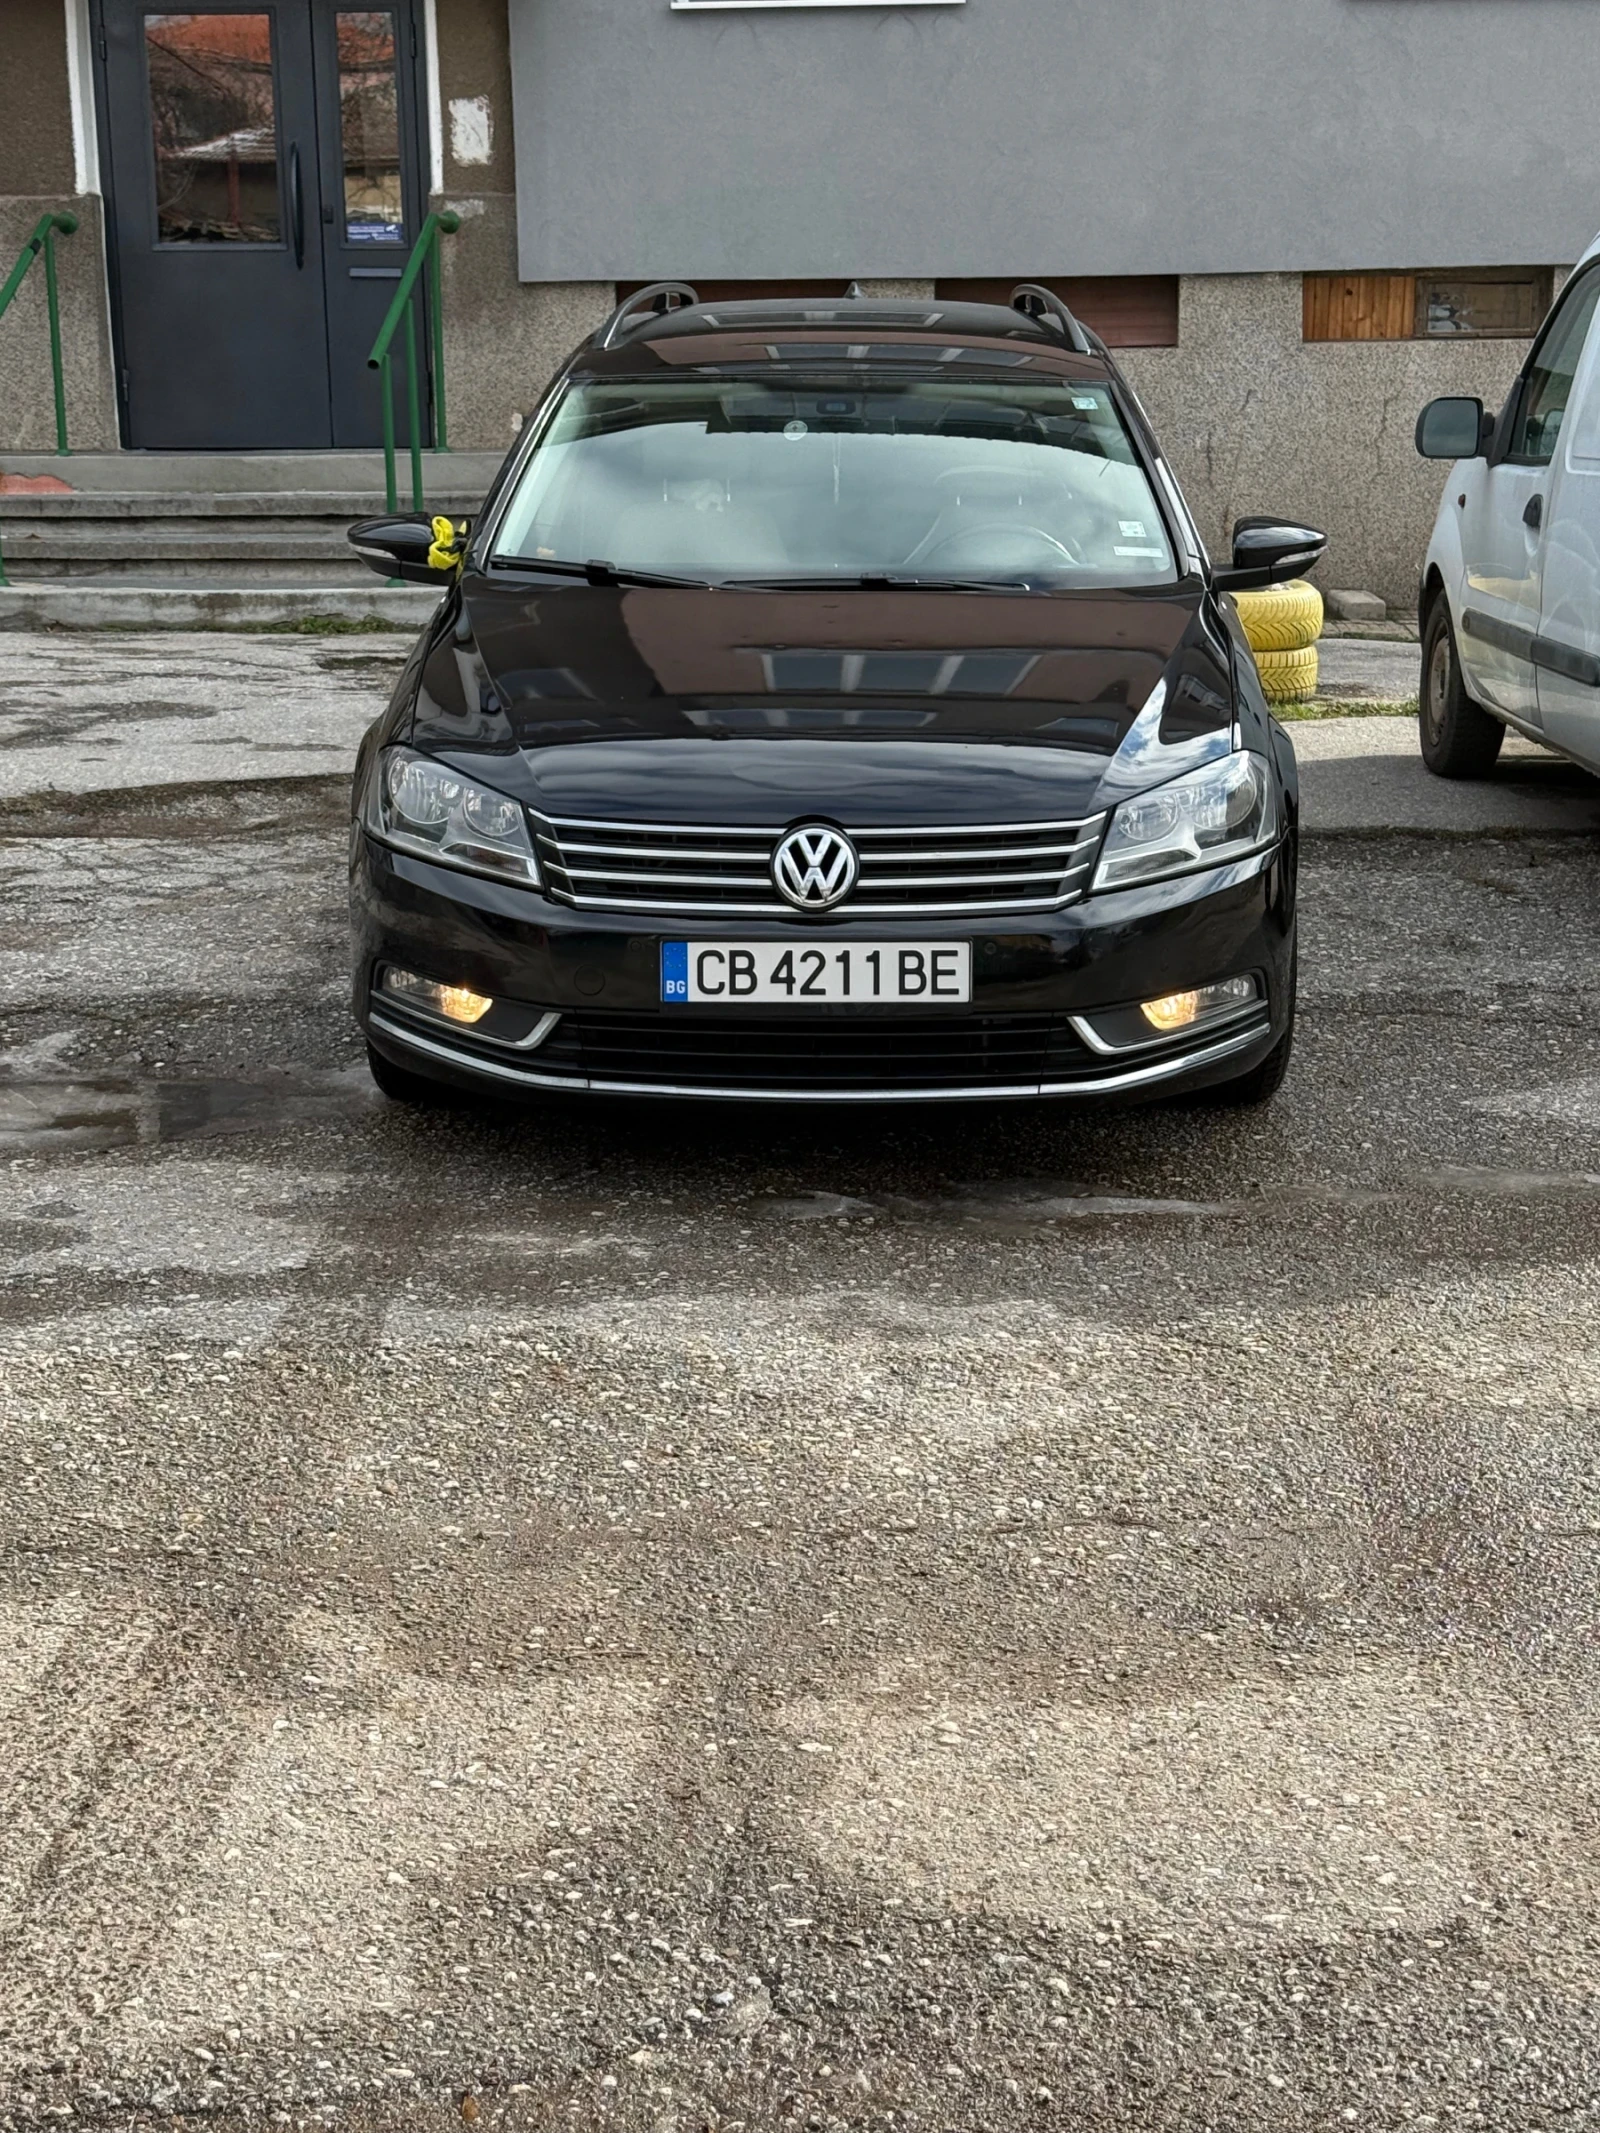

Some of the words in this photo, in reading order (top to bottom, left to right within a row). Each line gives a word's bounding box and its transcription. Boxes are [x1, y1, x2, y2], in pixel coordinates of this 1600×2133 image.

[776, 830, 853, 905] VW
[665, 980, 686, 995] BG
[696, 949, 758, 996] CB
[769, 949, 881, 996] 4211
[898, 949, 960, 996] BE
